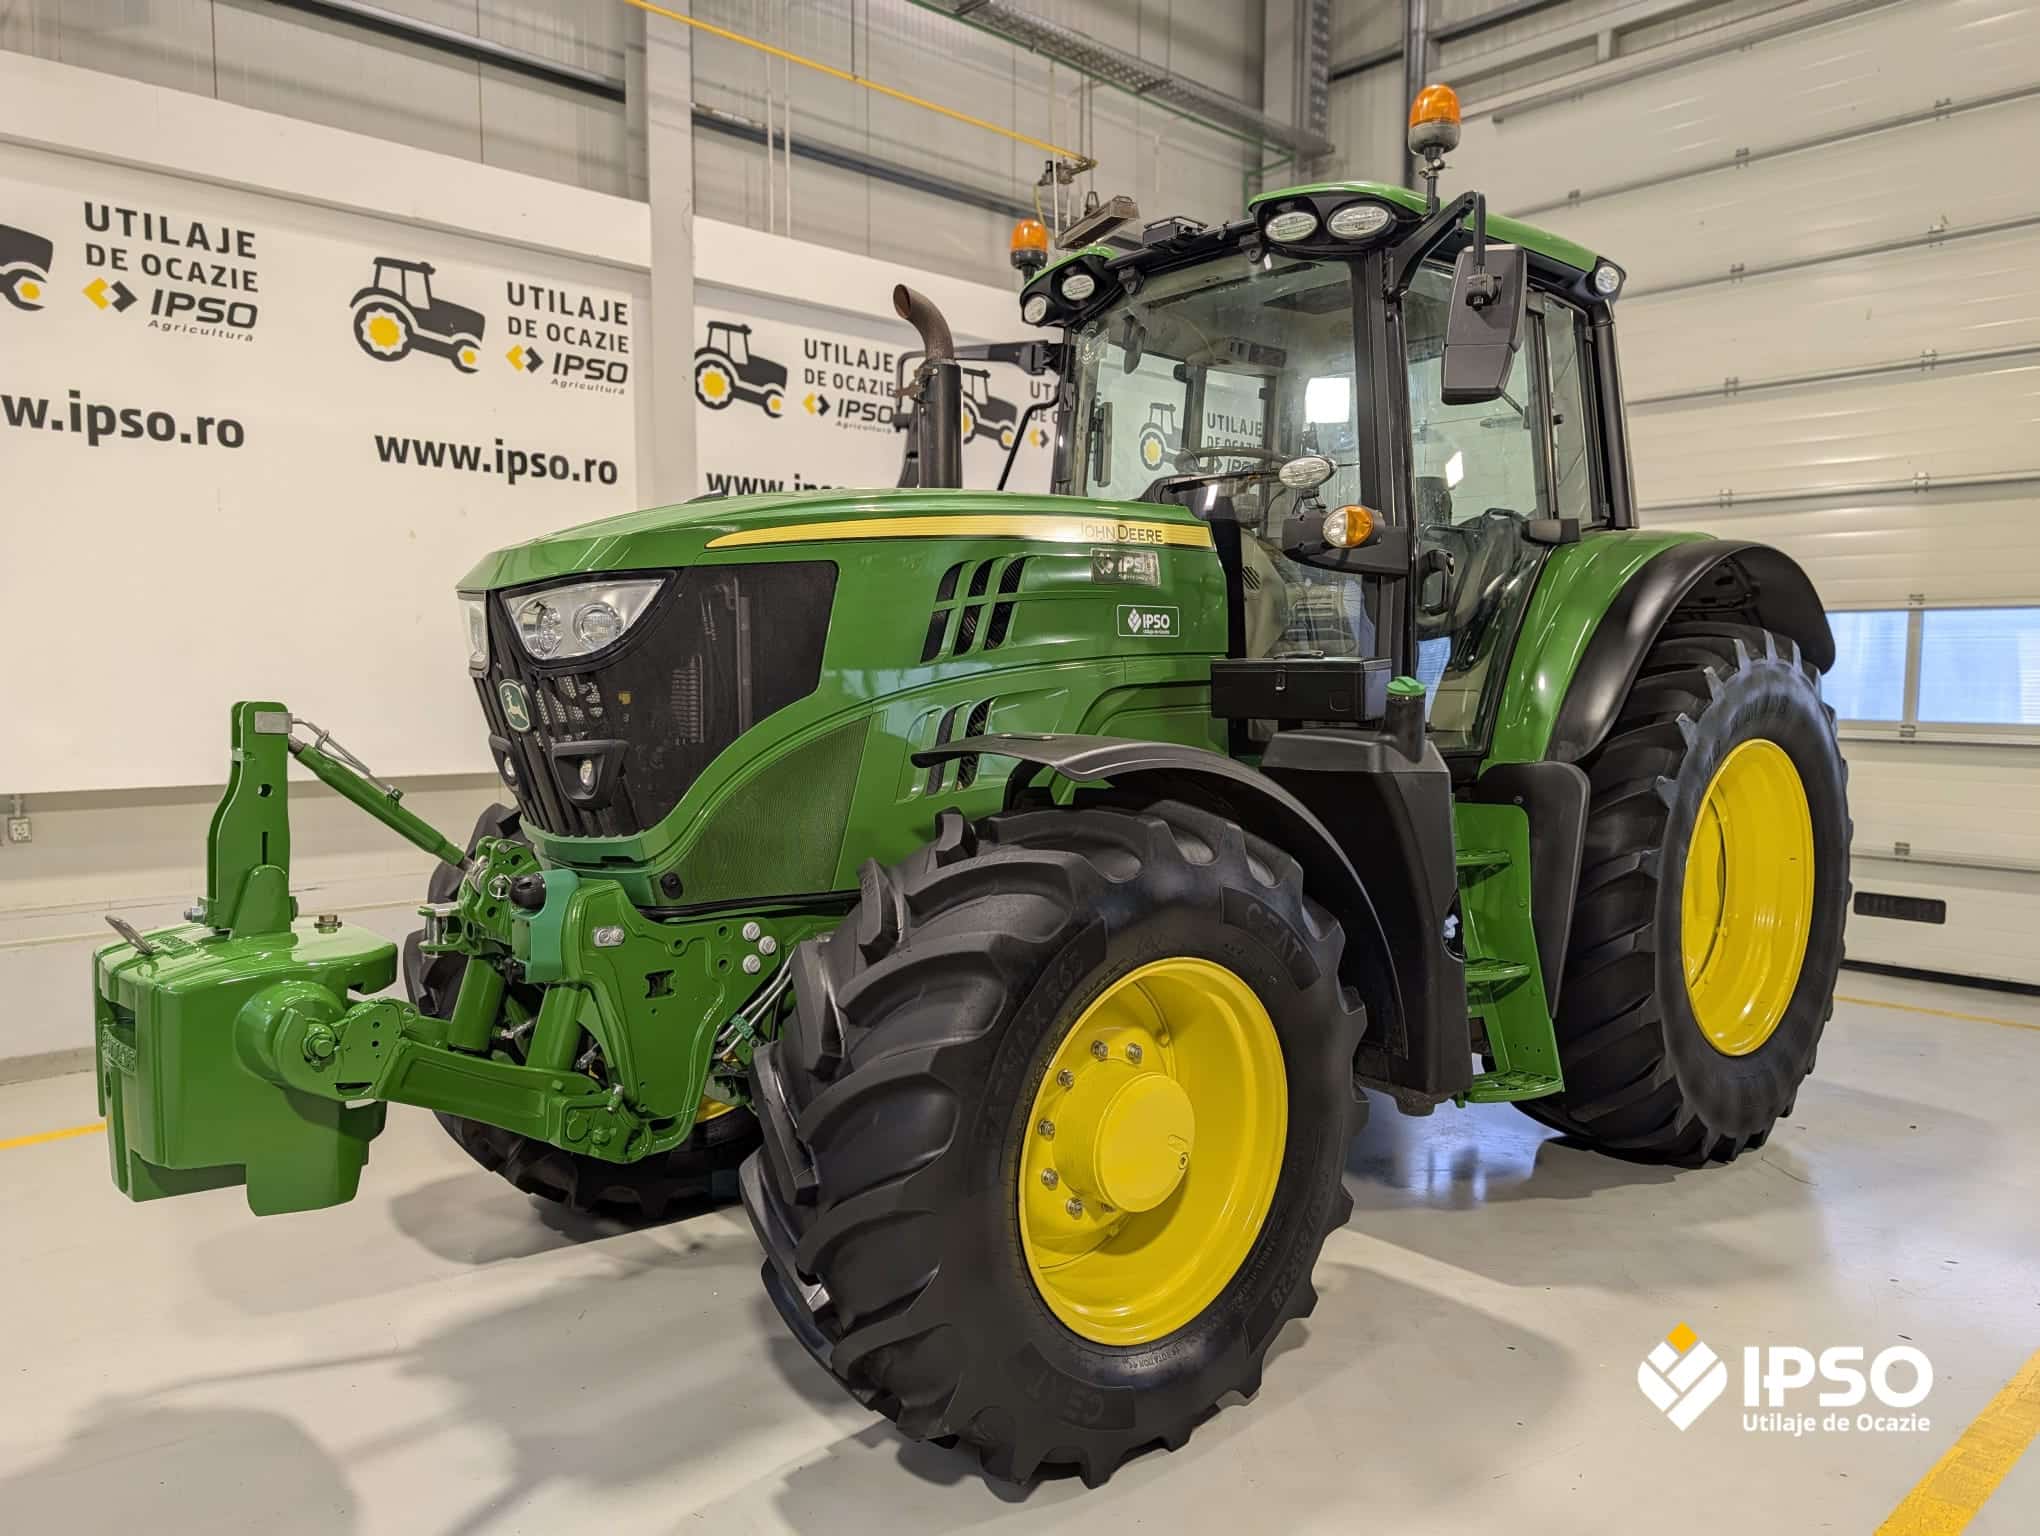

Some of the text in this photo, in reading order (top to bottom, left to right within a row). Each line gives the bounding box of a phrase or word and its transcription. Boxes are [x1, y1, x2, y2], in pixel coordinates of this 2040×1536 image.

[84, 201, 257, 259] UTILAJE
[85, 243, 259, 293] DE OCAZIE
[150, 288, 259, 330] IPSO
[506, 281, 629, 326] UTILAJE
[508, 316, 629, 354] DE OCAZIE
[552, 352, 629, 385] IPSO
[804, 338, 895, 374] UTILAJE
[804, 367, 898, 399] DE OCAZIE
[837, 398, 895, 425] IPSO
[1207, 413, 1263, 439] UTILAJE
[374, 435, 619, 486] www.ipso.ro
[1118, 524, 1163, 543] DEERE
[1142, 613, 1170, 629] IPSO
